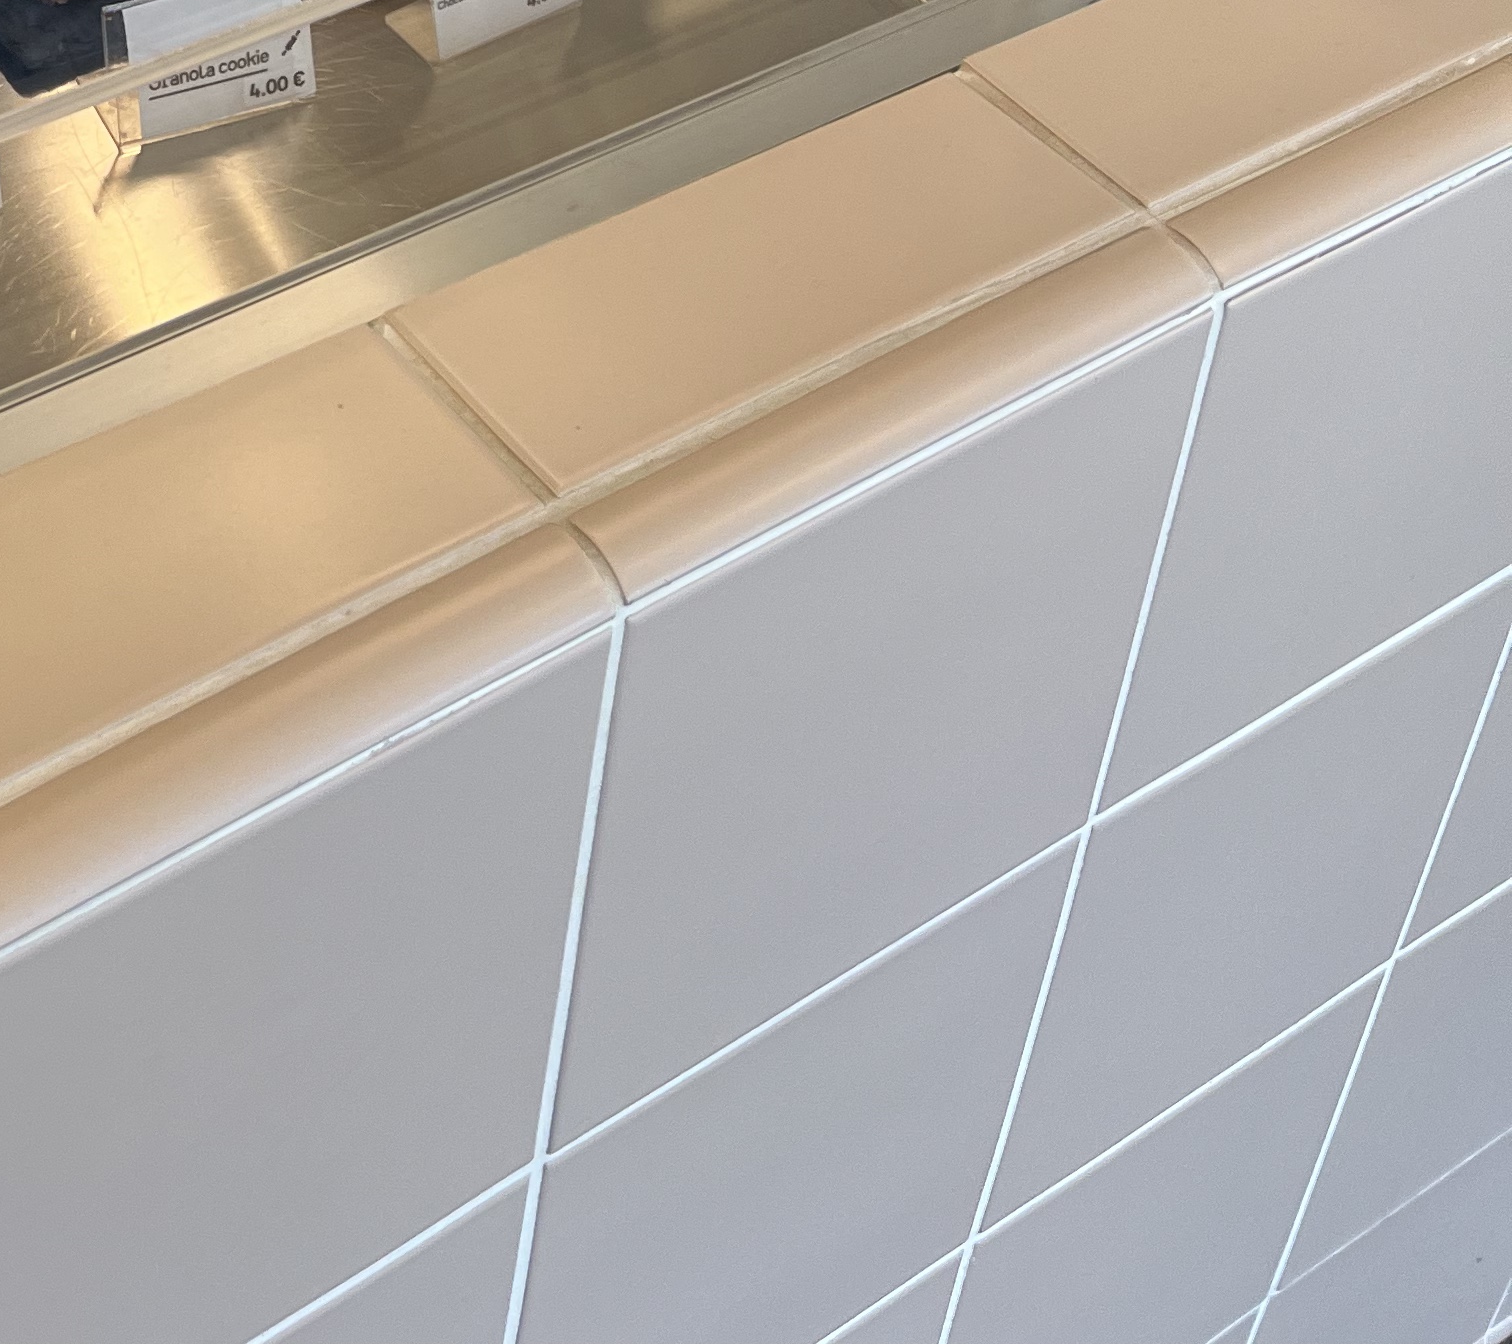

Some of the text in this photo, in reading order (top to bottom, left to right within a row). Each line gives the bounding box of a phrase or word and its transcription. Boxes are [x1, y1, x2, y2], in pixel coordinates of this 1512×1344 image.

[218, 49, 270, 75] cookie
[249, 70, 306, 98] 4.00 €
